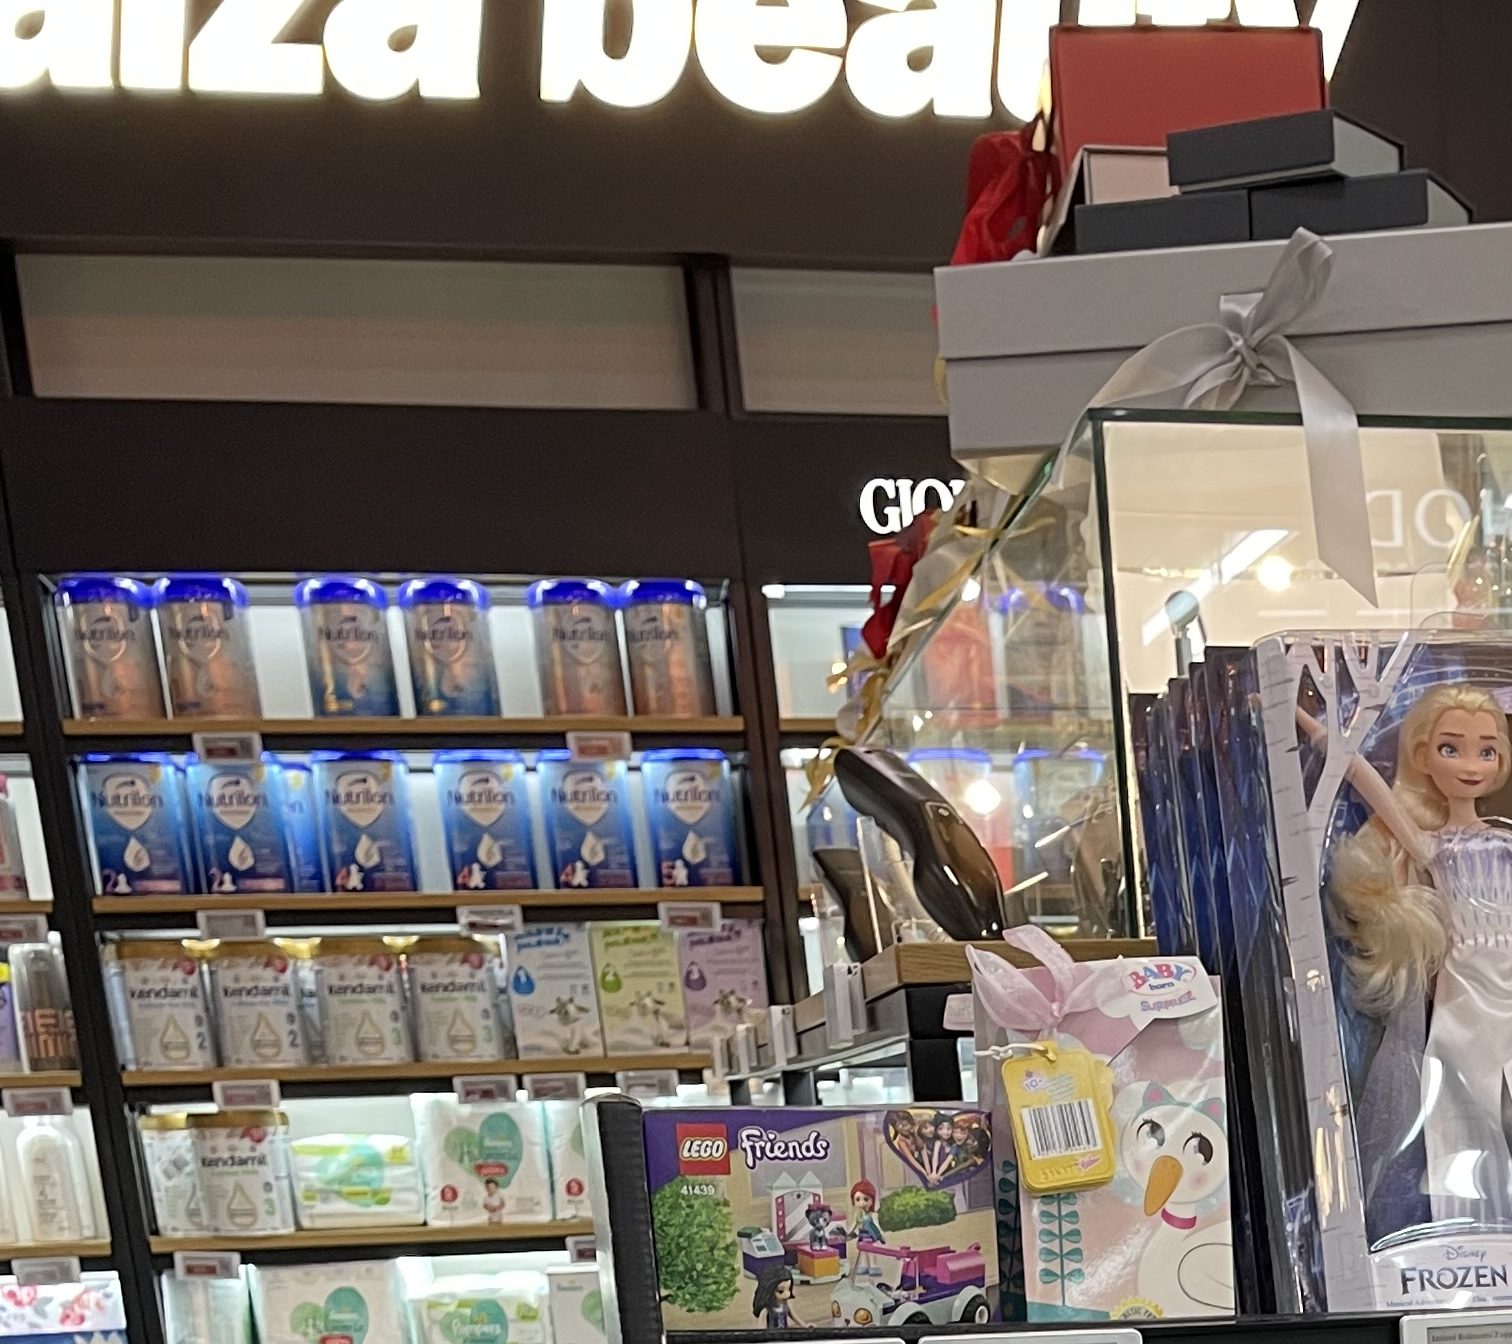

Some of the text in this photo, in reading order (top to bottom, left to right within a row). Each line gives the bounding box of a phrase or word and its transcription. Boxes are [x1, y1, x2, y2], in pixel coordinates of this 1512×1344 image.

[91, 792, 163, 809] Nutrilon
[198, 792, 268, 809] Nutrilon
[325, 788, 394, 807] Nutrilon
[447, 787, 515, 807] Nutrilon
[551, 787, 618, 806] Nutrilon
[654, 787, 720, 805] Nutrilon
[1129, 963, 1193, 989] BABY
[1149, 982, 1175, 991] born
[682, 1127, 831, 1169] LEGO Friends
[680, 1184, 715, 1196] 41439
[1400, 1265, 1508, 1295] FROZEN
